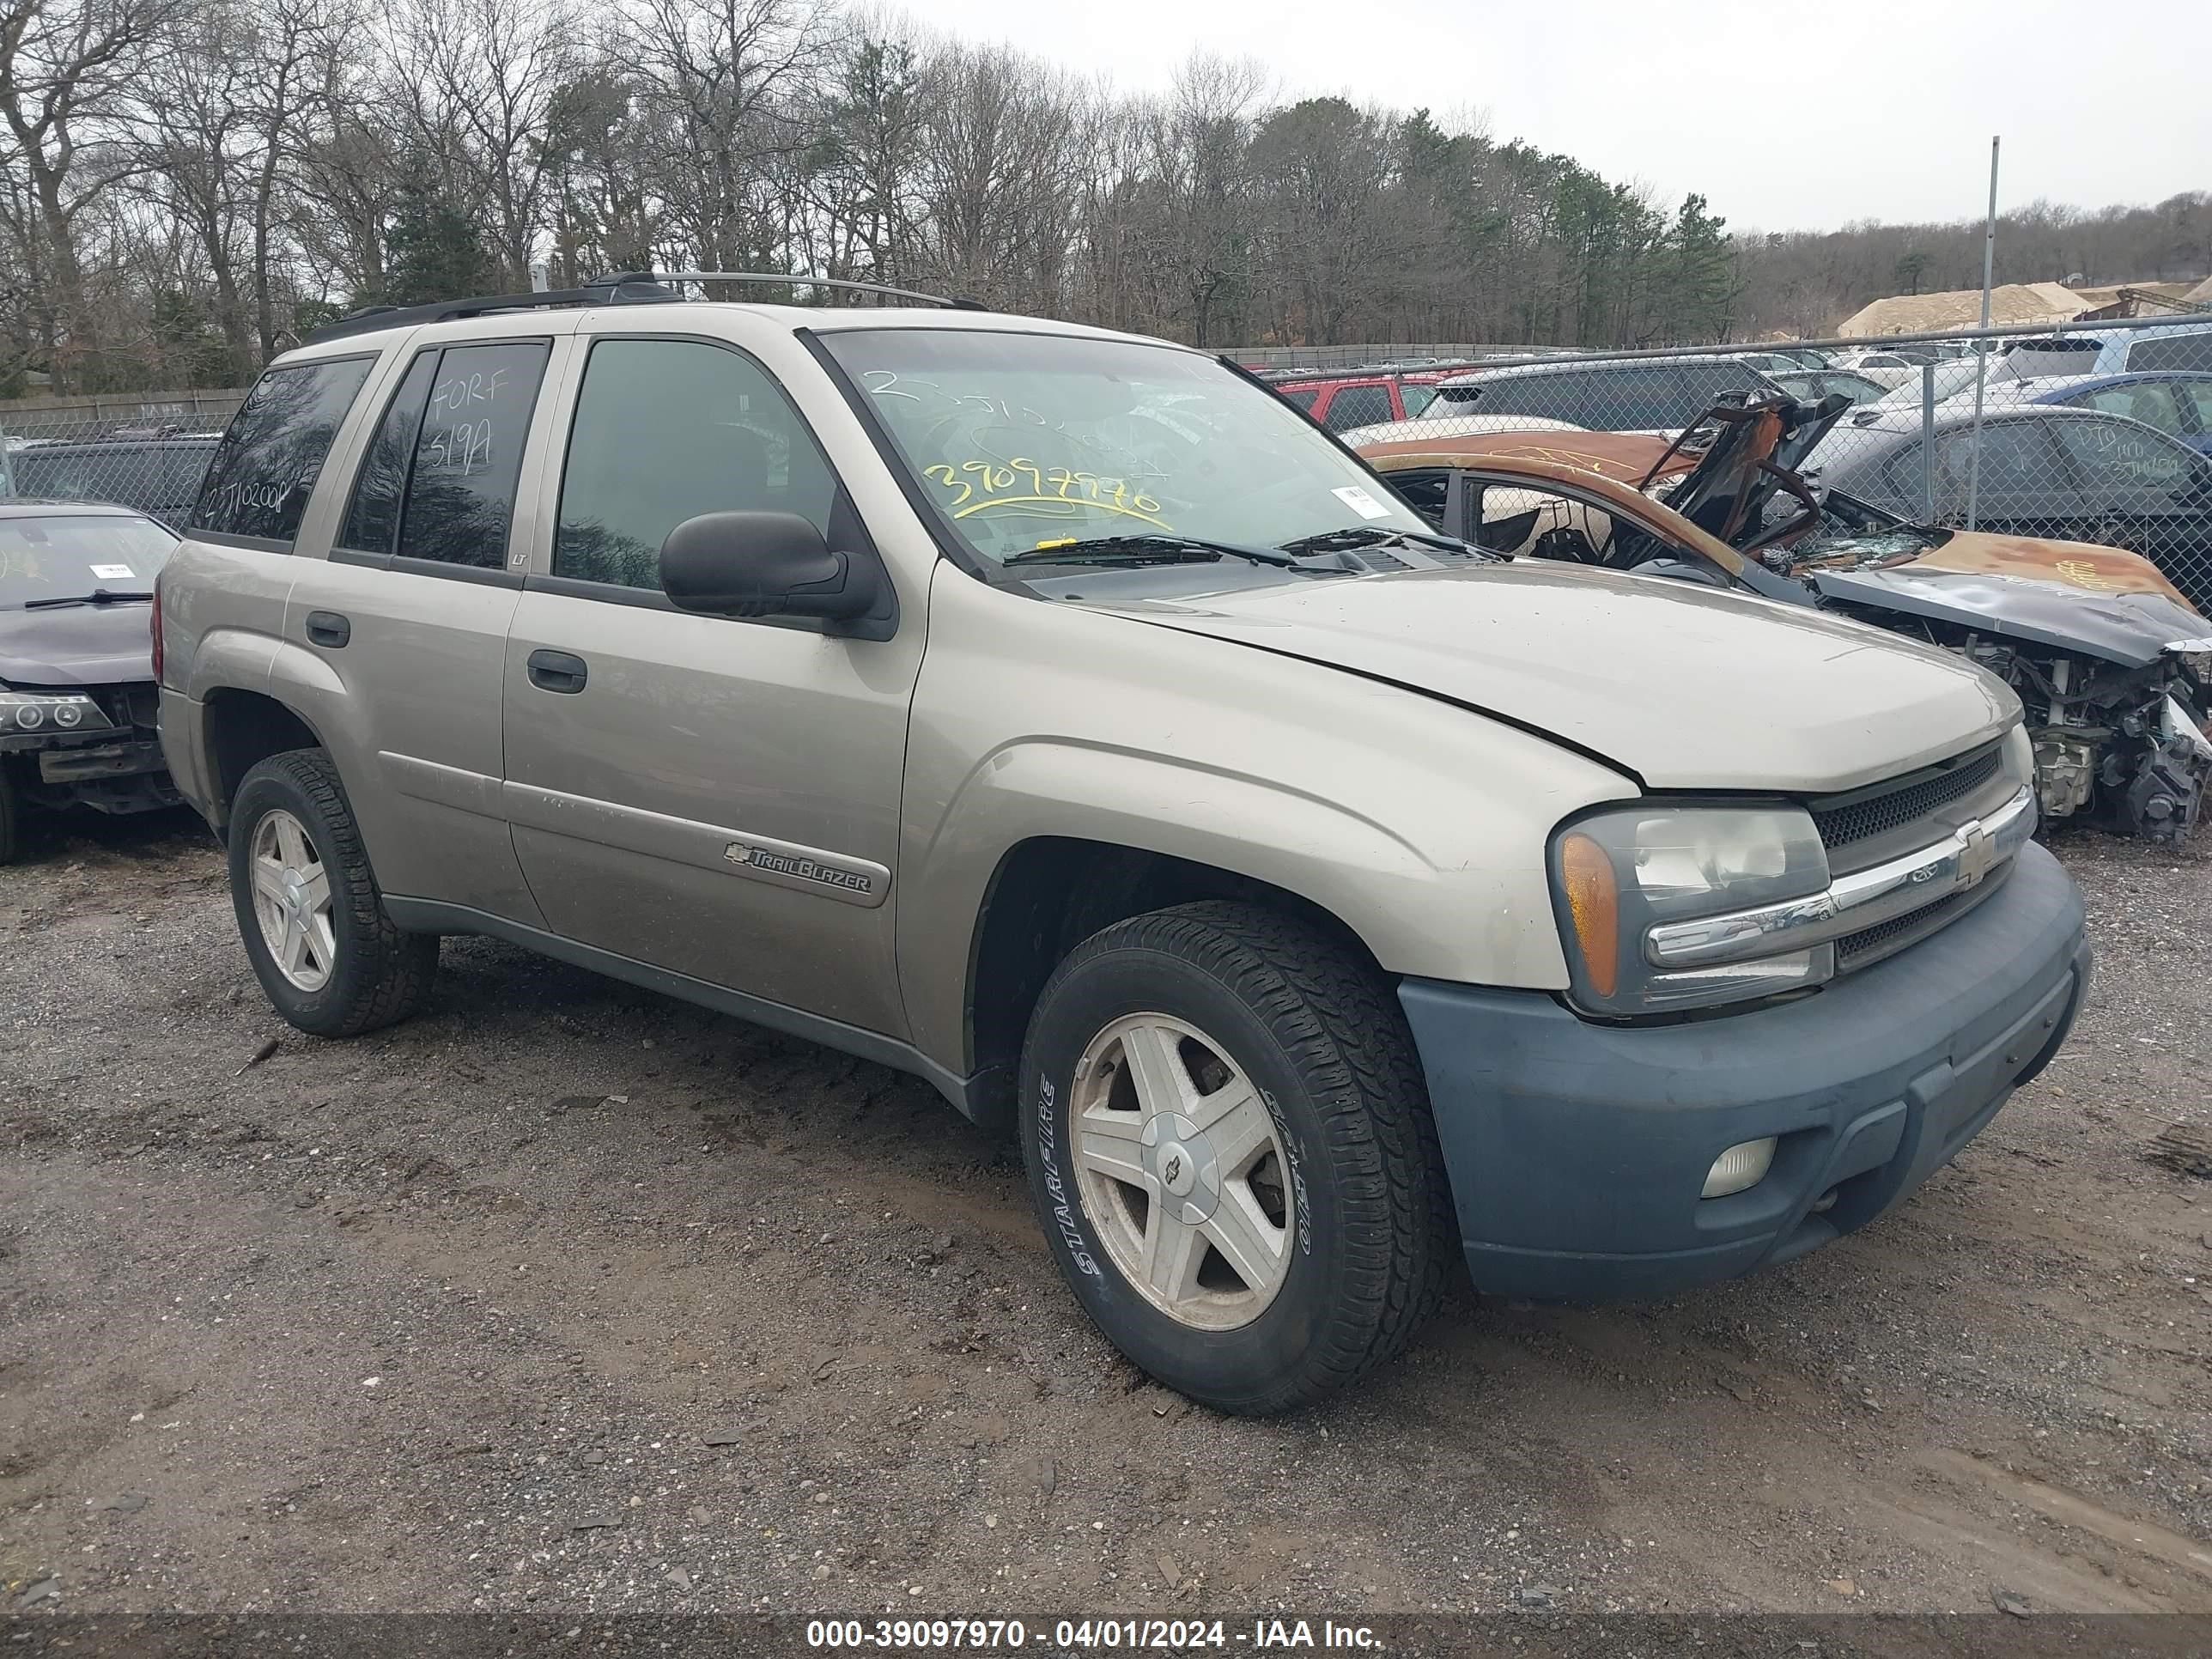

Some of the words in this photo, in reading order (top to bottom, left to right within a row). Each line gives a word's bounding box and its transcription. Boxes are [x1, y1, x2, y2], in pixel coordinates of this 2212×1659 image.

[512, 554, 528, 566] LT
[752, 850, 871, 891] TRAILBLAZER
[1038, 1072, 1100, 1276] STARFIRE
